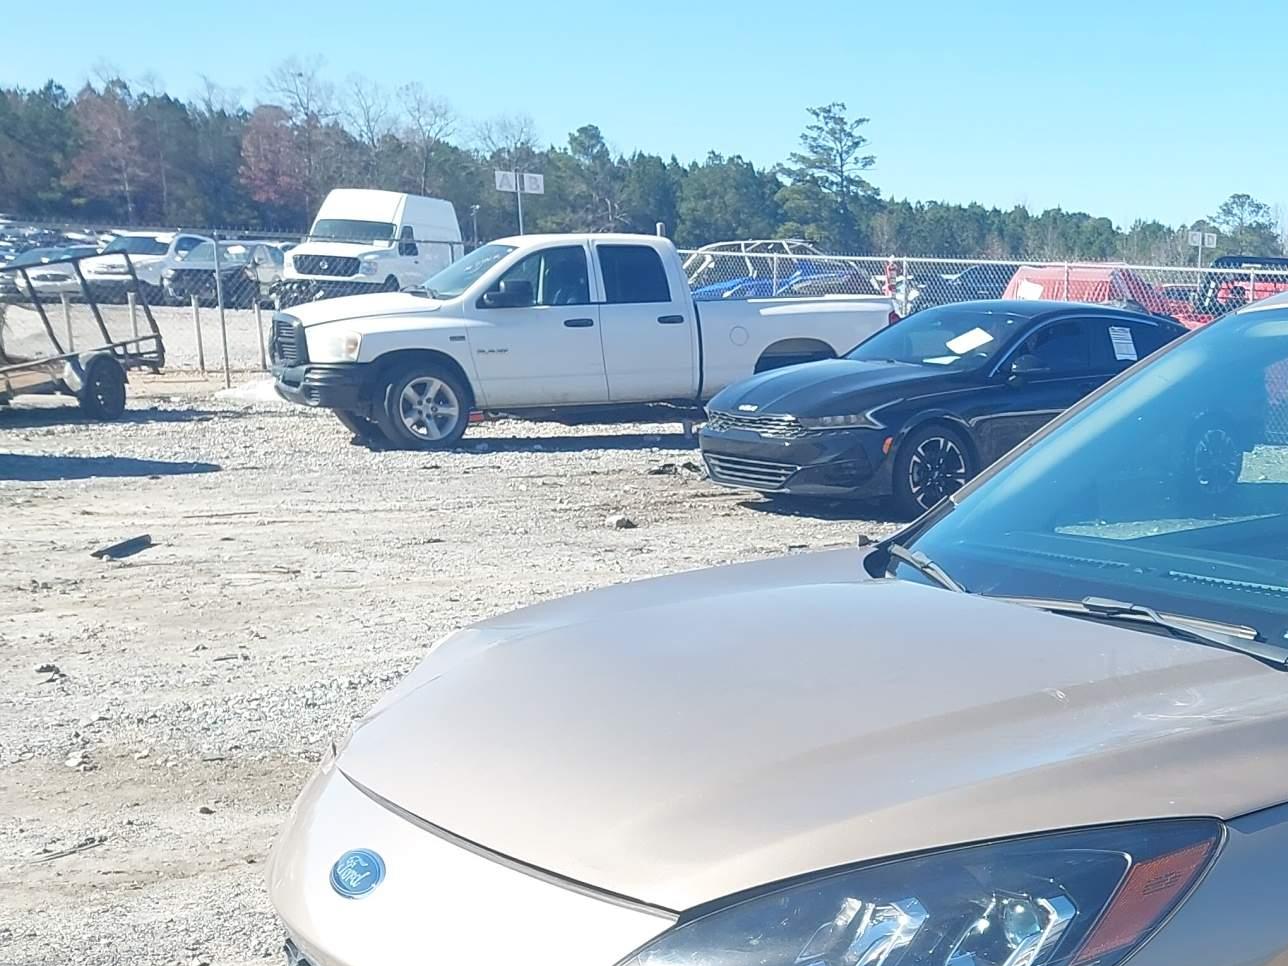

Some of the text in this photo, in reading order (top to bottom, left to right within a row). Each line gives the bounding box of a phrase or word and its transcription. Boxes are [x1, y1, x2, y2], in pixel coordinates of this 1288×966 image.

[499, 173, 540, 191] A B
[336, 855, 371, 888] Ford
